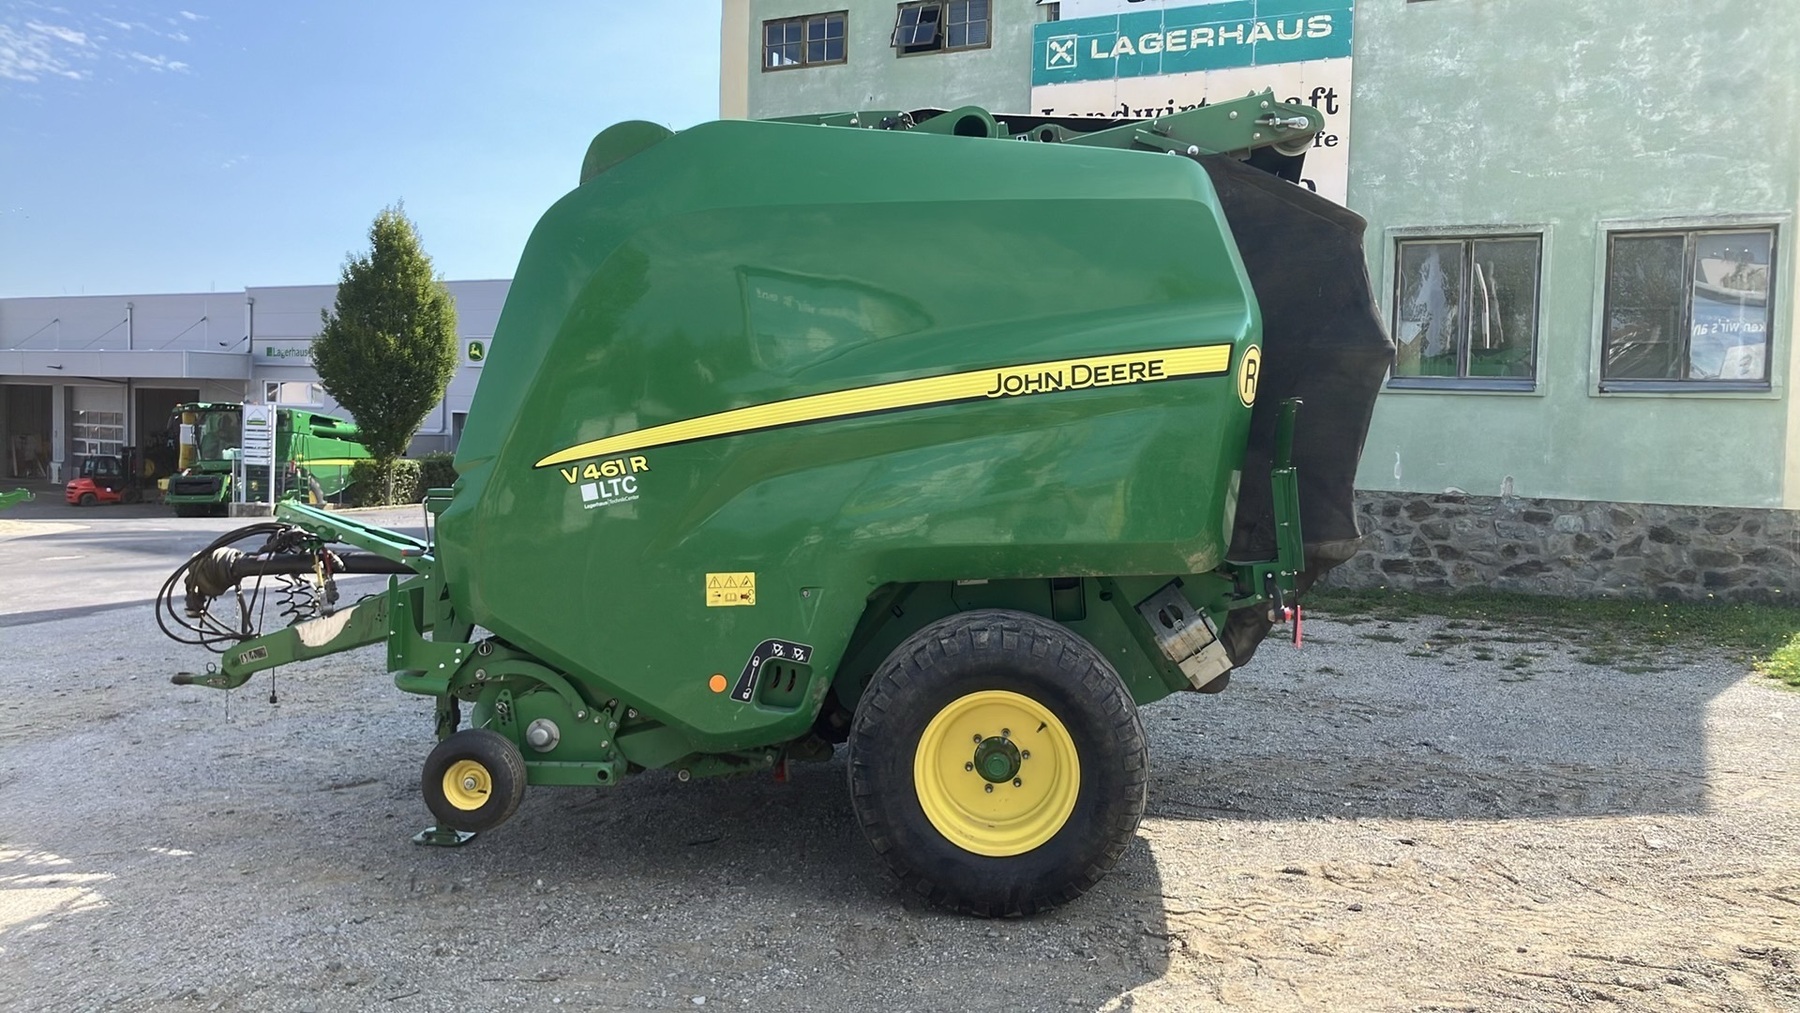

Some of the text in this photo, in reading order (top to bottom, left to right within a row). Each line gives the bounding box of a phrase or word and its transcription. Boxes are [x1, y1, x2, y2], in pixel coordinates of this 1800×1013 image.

[1091, 14, 1332, 59] LAGERHAUS
[273, 347, 307, 359] Lagerhaus
[987, 359, 1165, 396] JOHN DEERE
[1245, 359, 1258, 394] R
[560, 455, 650, 485] V 461 R
[599, 476, 638, 499] LTC
